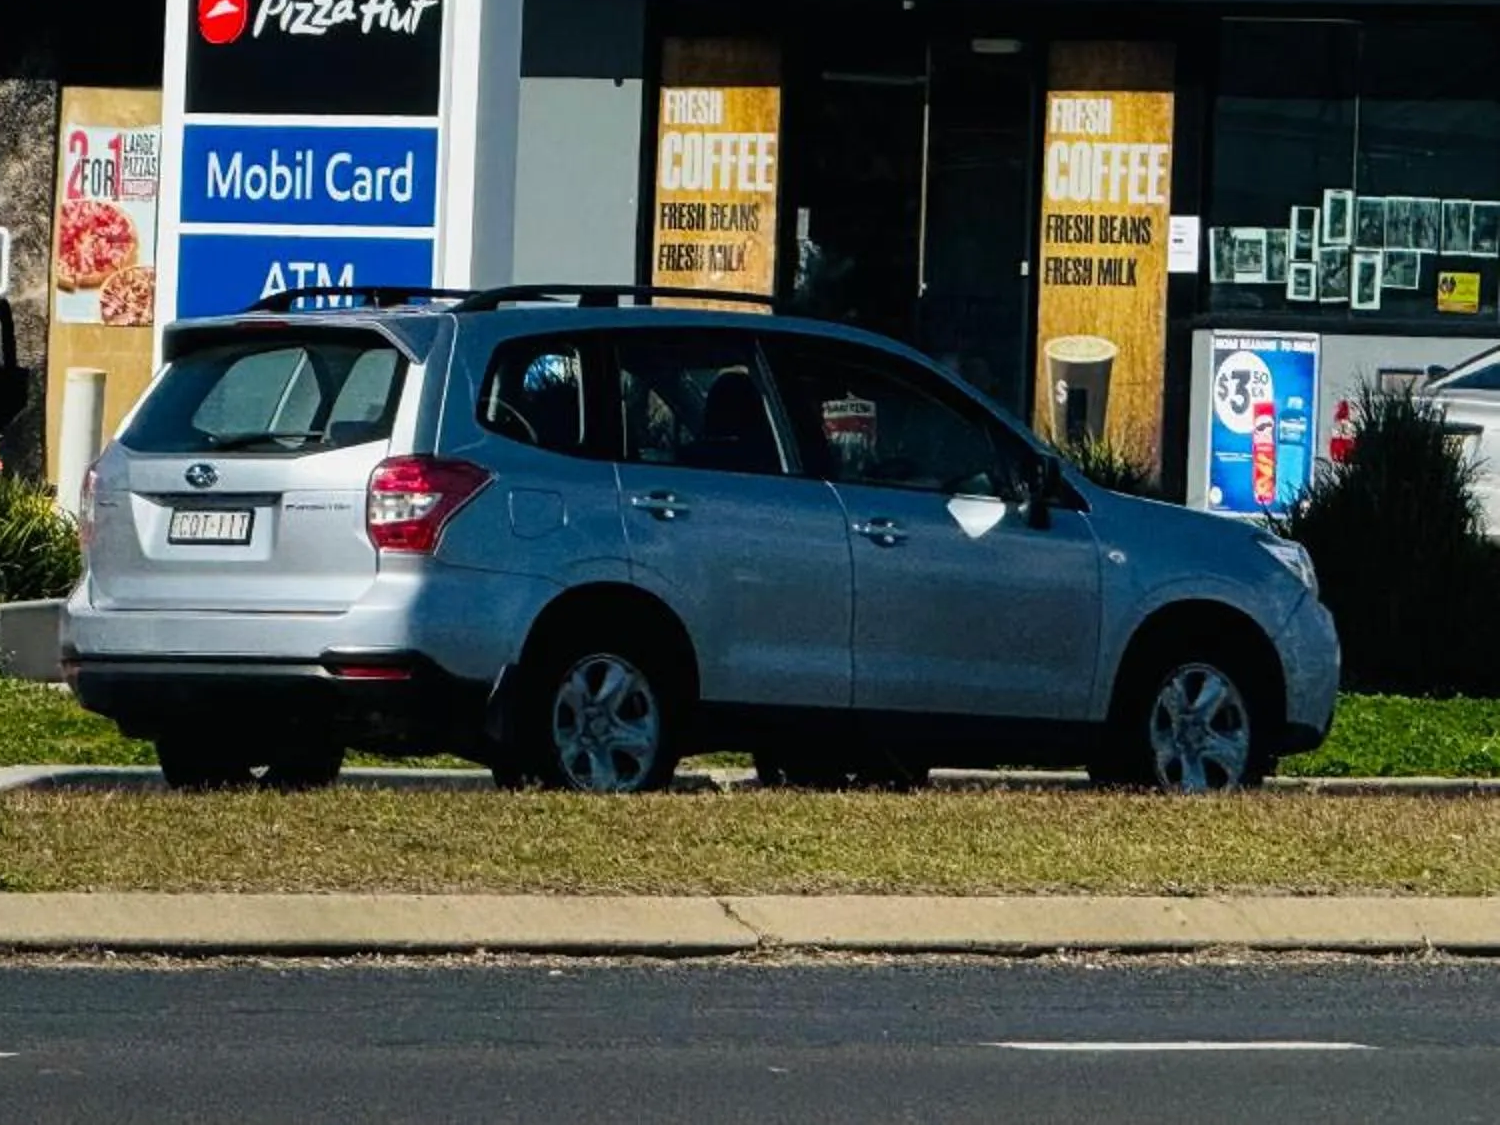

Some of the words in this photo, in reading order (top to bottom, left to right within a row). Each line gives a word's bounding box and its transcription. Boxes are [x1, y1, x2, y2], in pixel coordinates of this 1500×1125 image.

[663, 89, 723, 124] FRESH
[1050, 98, 1111, 135] FRESH
[67, 130, 89, 200] 2
[81, 158, 115, 197] FOR
[108, 132, 122, 201] 1
[207, 149, 313, 201] Mobil
[325, 150, 414, 202] Card
[660, 131, 777, 192] COFFEE
[1047, 140, 1169, 204] COFFEE
[660, 202, 706, 231] FRESH
[710, 202, 760, 232] BEANS
[1045, 214, 1094, 244] FRESH
[1099, 215, 1151, 245] BEANS
[658, 244, 704, 272] FRESH
[1044, 257, 1093, 286] FRESH
[1096, 258, 1137, 287] MILK
[260, 261, 354, 308] ATM
